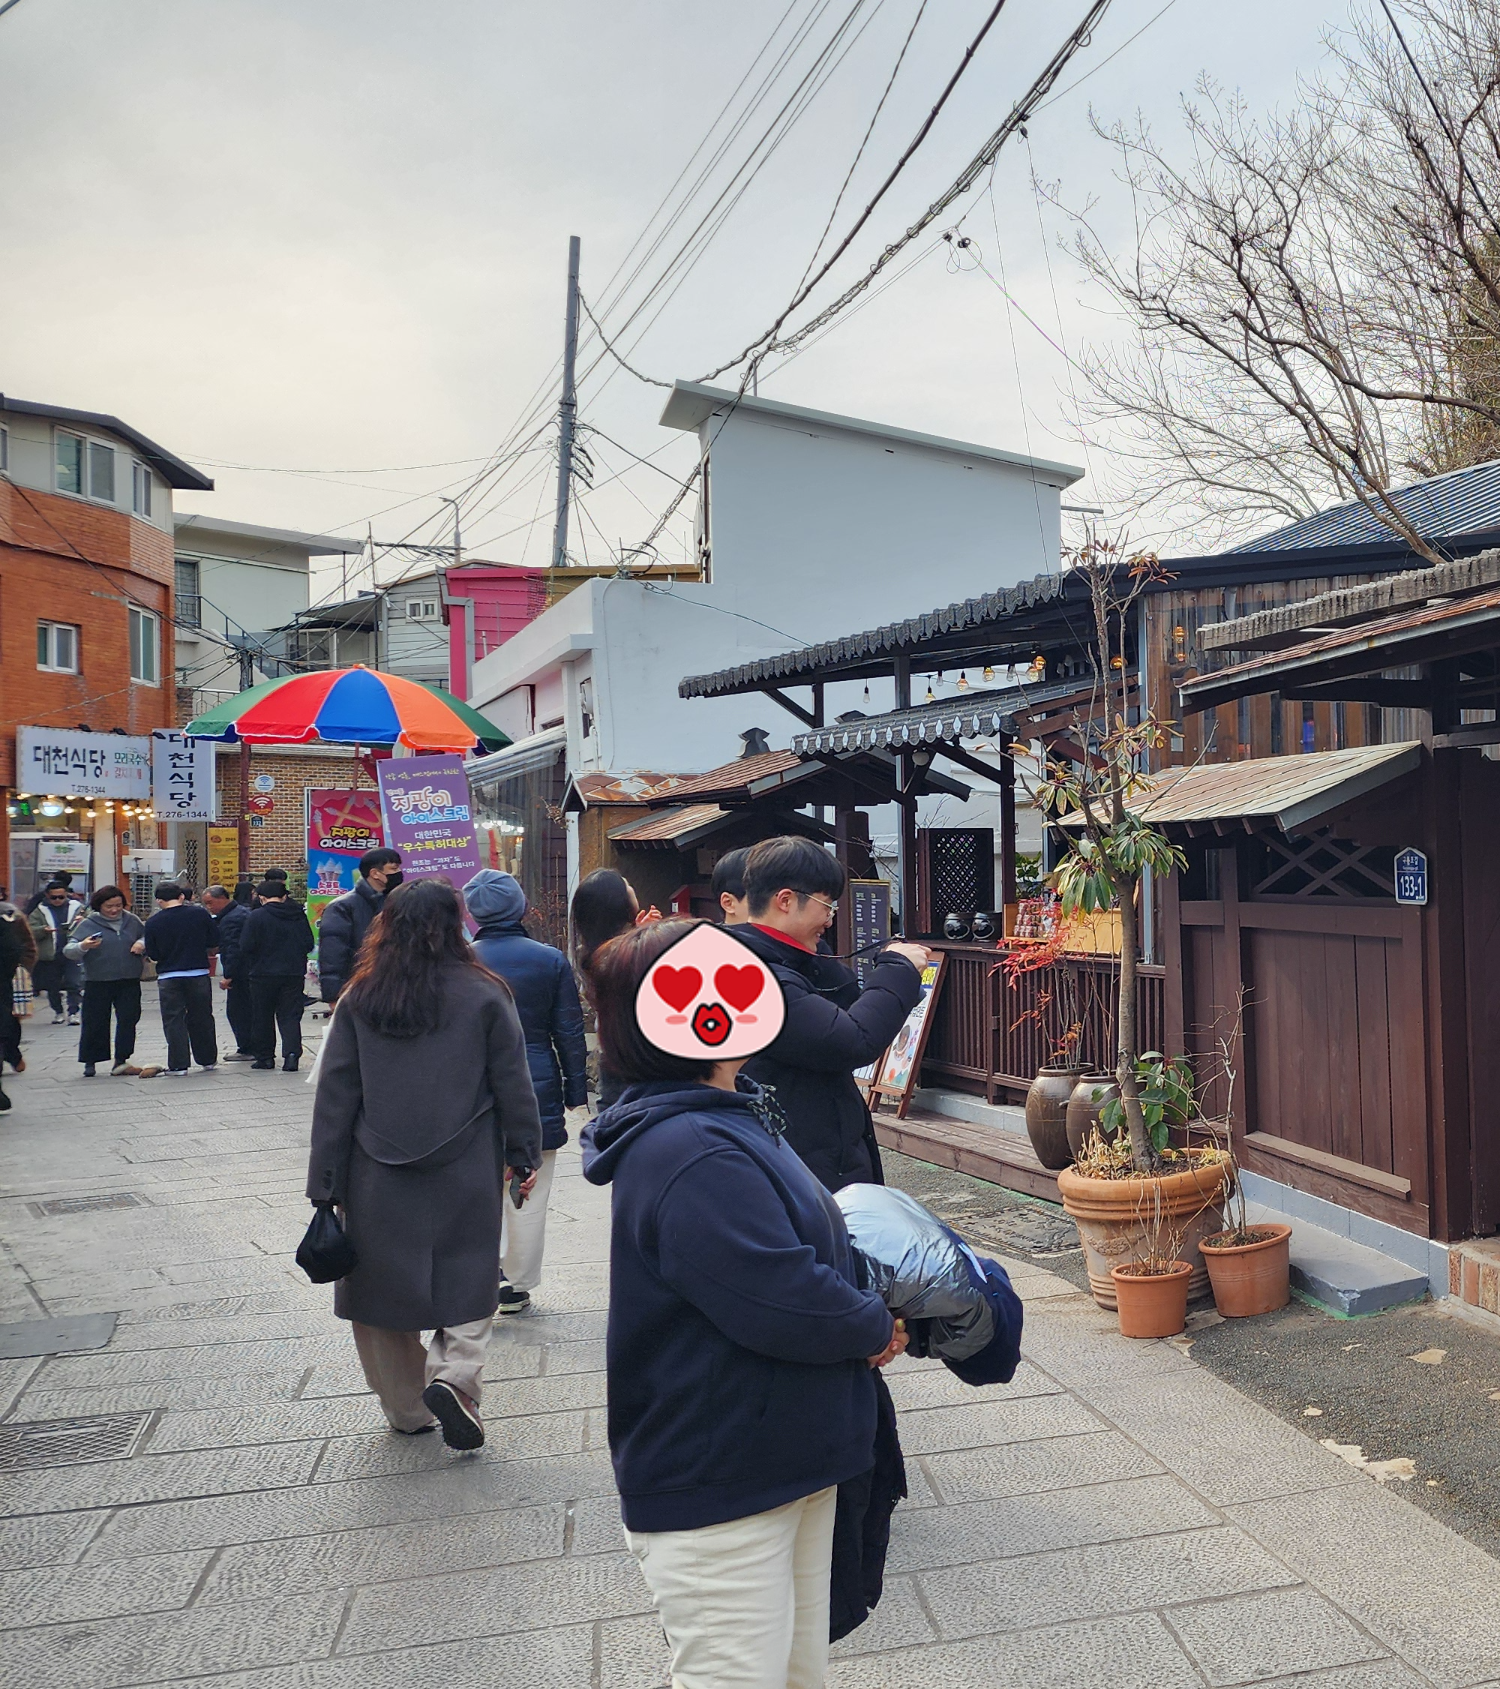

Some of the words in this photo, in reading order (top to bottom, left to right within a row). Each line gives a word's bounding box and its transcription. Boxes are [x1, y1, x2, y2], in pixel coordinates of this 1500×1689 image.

[33, 745, 106, 778] 대천식당
[168, 733, 197, 808] 대천식당
[390, 786, 452, 813] 지팡이
[401, 805, 470, 824] 아이스크림
[331, 826, 370, 838] 지팡이
[414, 828, 452, 839] 대한민국
[1400, 875, 1422, 897] 133-1
